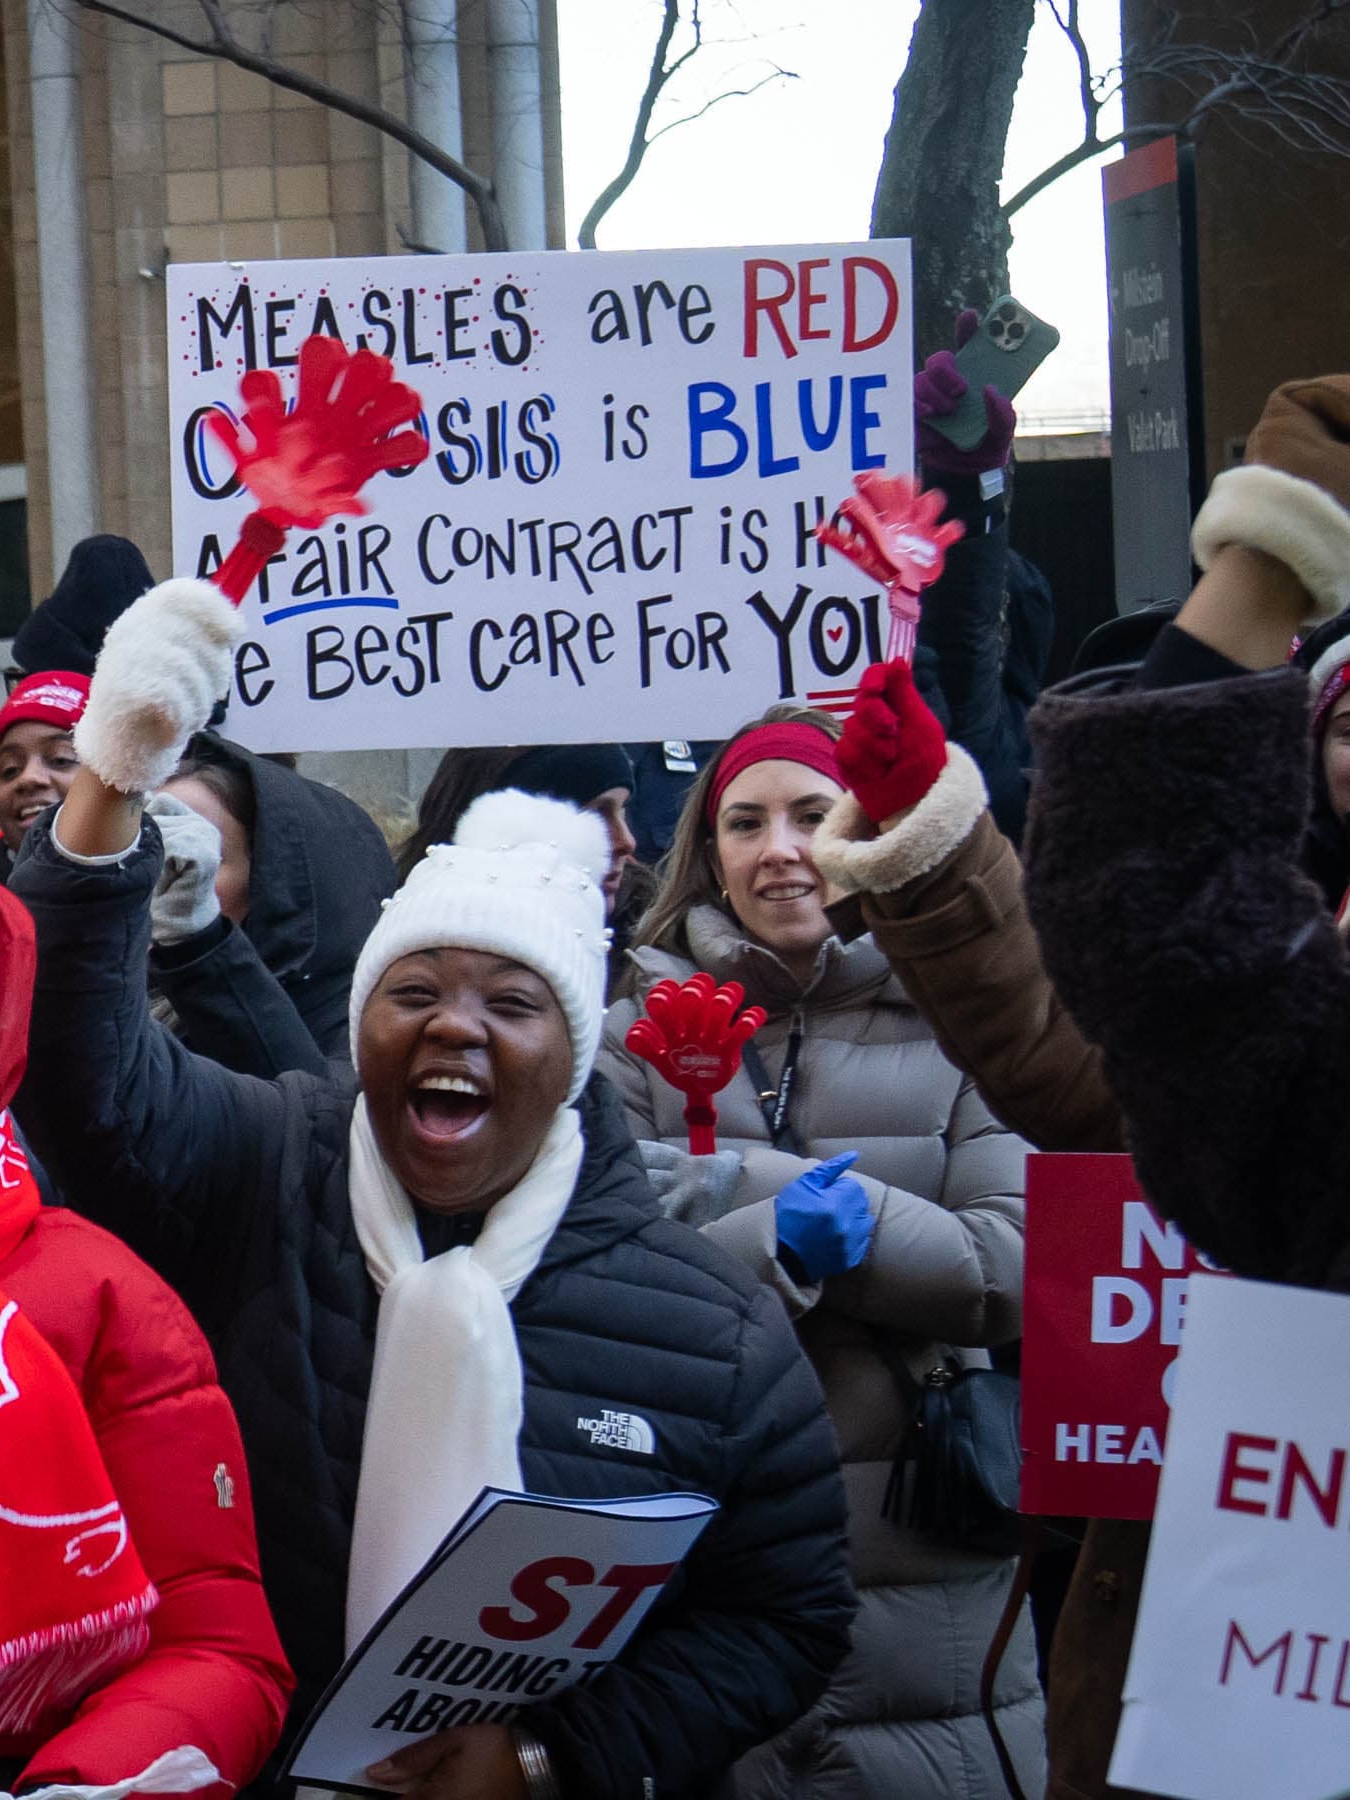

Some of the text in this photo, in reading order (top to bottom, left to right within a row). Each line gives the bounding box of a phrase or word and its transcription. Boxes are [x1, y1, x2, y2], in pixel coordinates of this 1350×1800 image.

[590, 279, 716, 346] are
[742, 256, 900, 360] RED
[602, 393, 649, 462] is
[688, 373, 888, 480] BLUE
[577, 1417, 628, 1437] NORTH
[590, 1431, 627, 1449] FACE
[600, 1409, 630, 1425] THE
[1216, 1431, 1350, 1530] EN
[393, 1635, 570, 1696] HIDING
